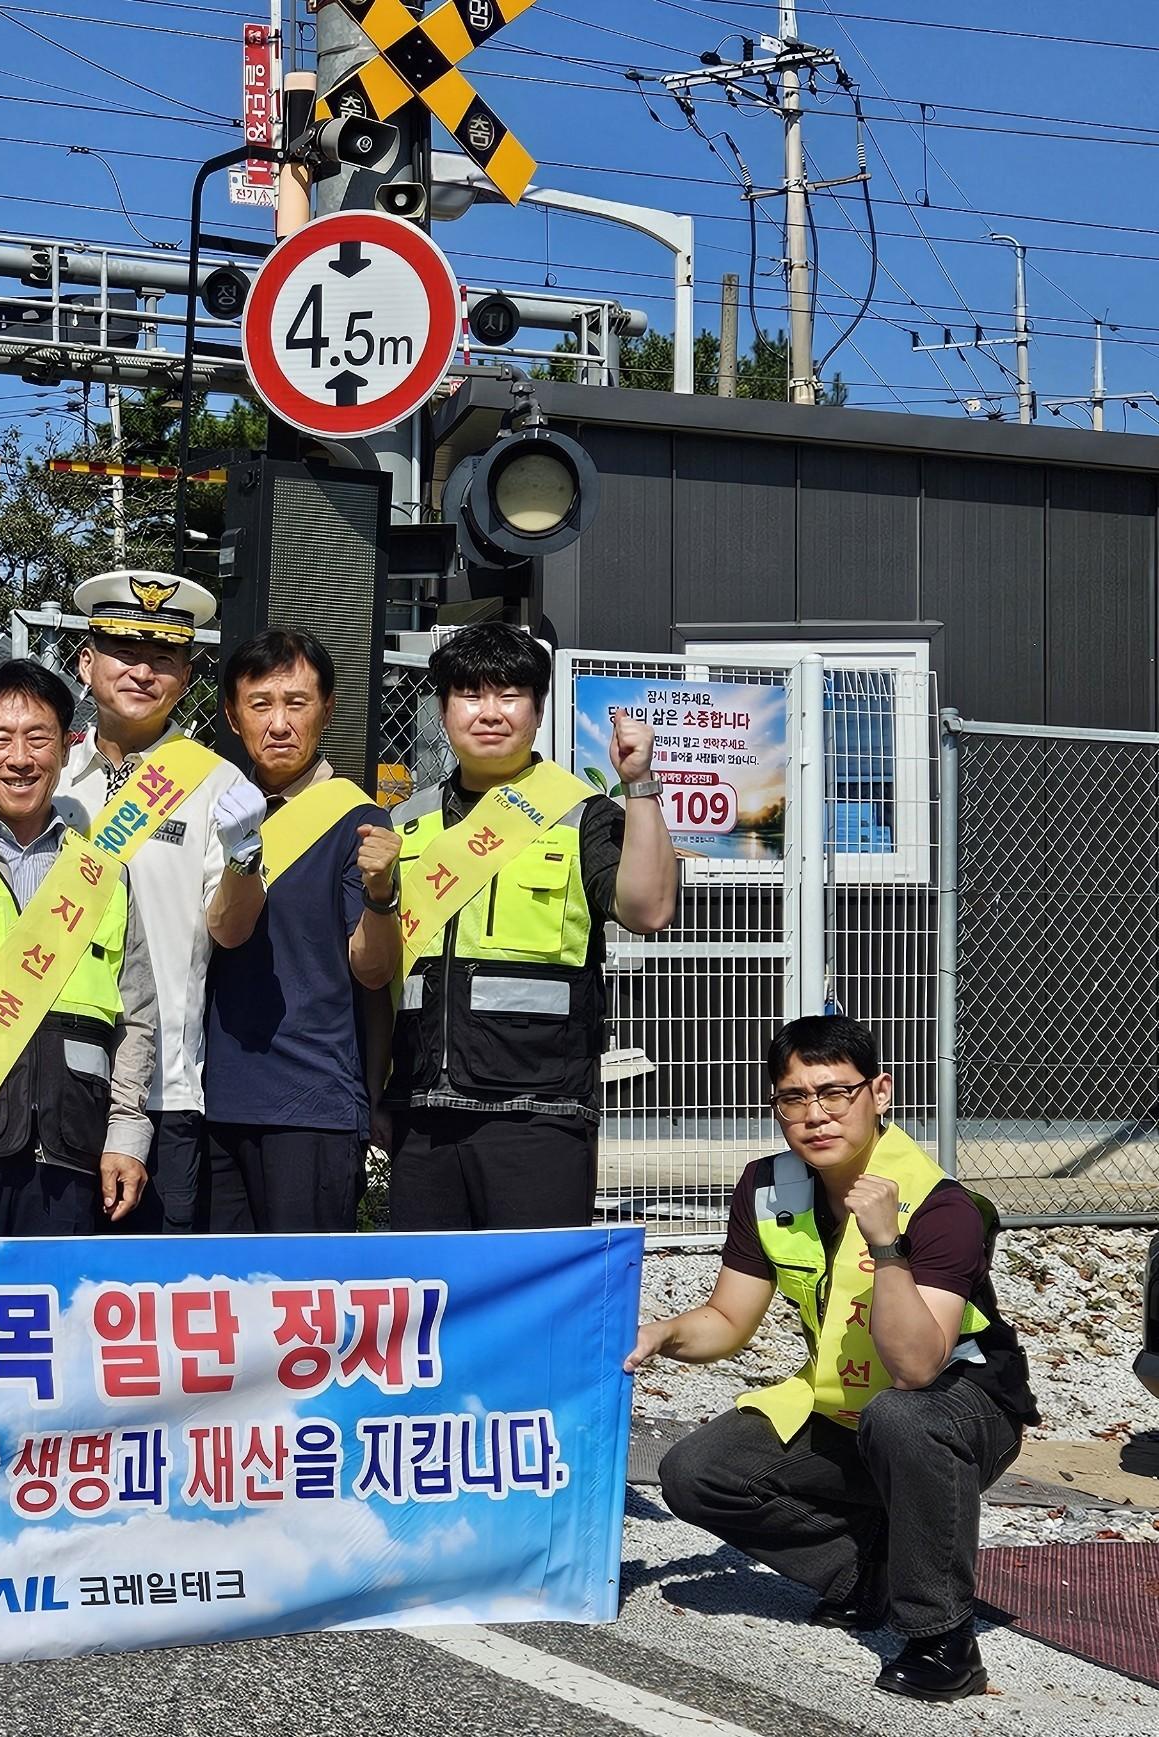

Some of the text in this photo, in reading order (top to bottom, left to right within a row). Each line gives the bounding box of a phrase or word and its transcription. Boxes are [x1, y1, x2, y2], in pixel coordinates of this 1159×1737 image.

[236, 188, 257, 201] 전기
[216, 284, 238, 306] 정
[285, 283, 413, 369] 4.5m
[484, 311, 505, 335] 지
[647, 690, 668, 704] 잠시
[652, 708, 678, 726] 삶은
[683, 710, 751, 730] 소중합니다
[654, 735, 680, 748] 민하지
[493, 794, 513, 811] TECH
[499, 785, 546, 826] KORAIL
[671, 791, 729, 825] 109
[154, 831, 182, 844] OLICE
[93, 1290, 240, 1397] 일단
[271, 1287, 440, 1391] 정지!
[13, 1429, 167, 1512] 생명과
[188, 1424, 337, 1502] 재산을
[360, 1415, 564, 1496] 지킵니다.
[79, 1569, 247, 1606] 코레일테크
